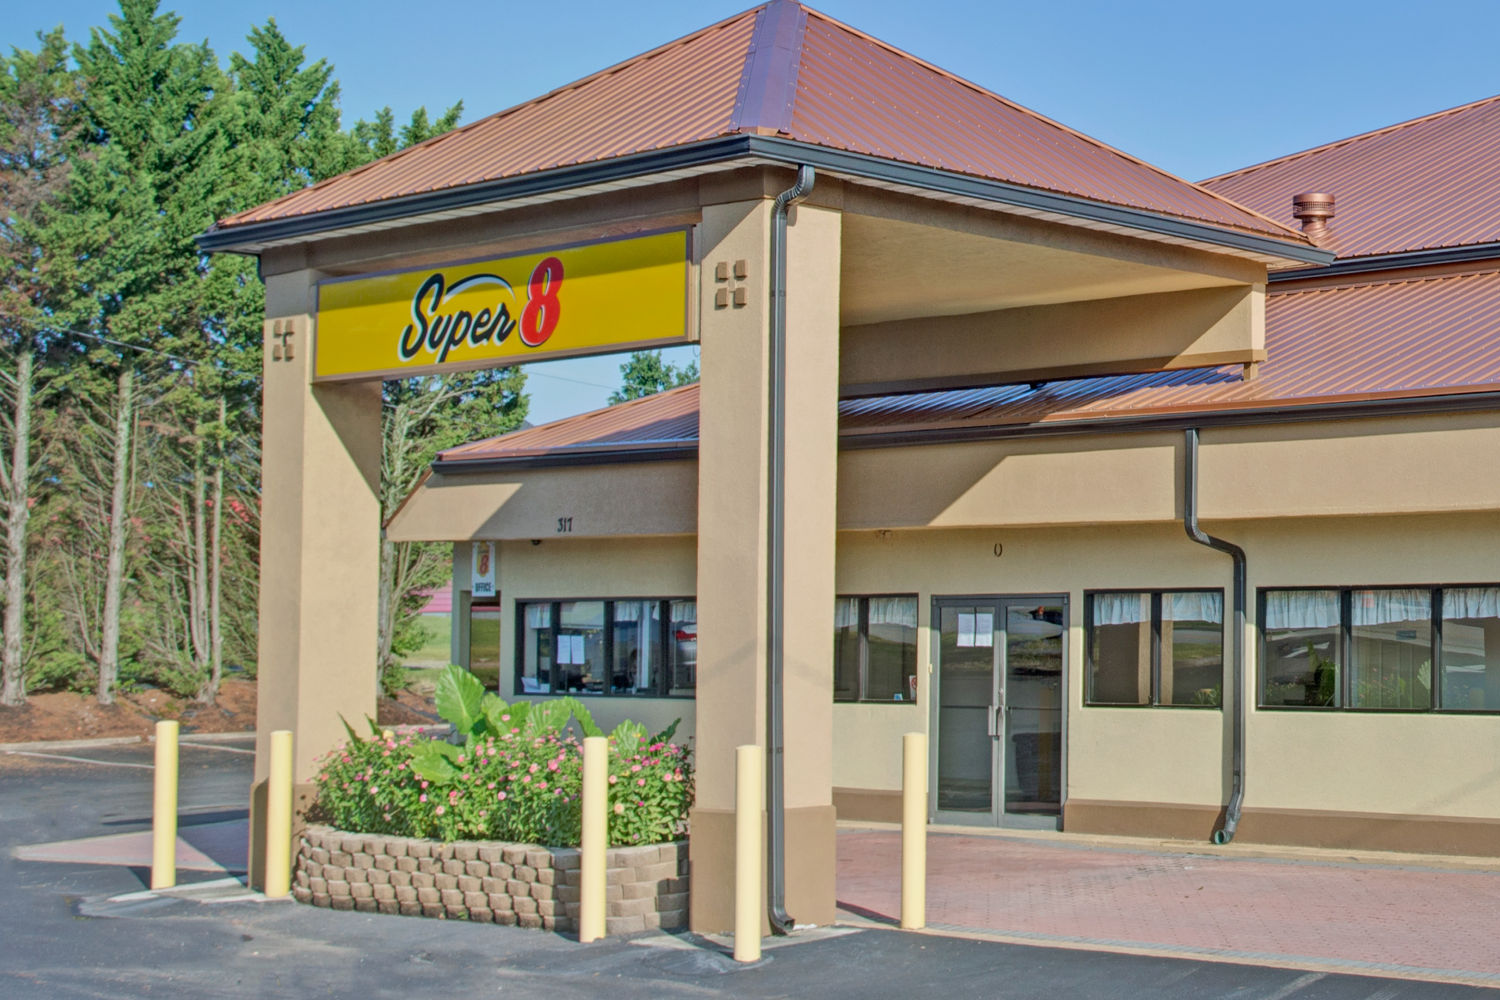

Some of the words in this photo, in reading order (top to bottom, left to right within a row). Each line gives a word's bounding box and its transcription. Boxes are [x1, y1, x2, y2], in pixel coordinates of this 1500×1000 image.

[398, 273, 517, 363] Super
[519, 257, 565, 348] 8
[474, 582, 493, 593] OFFICE
